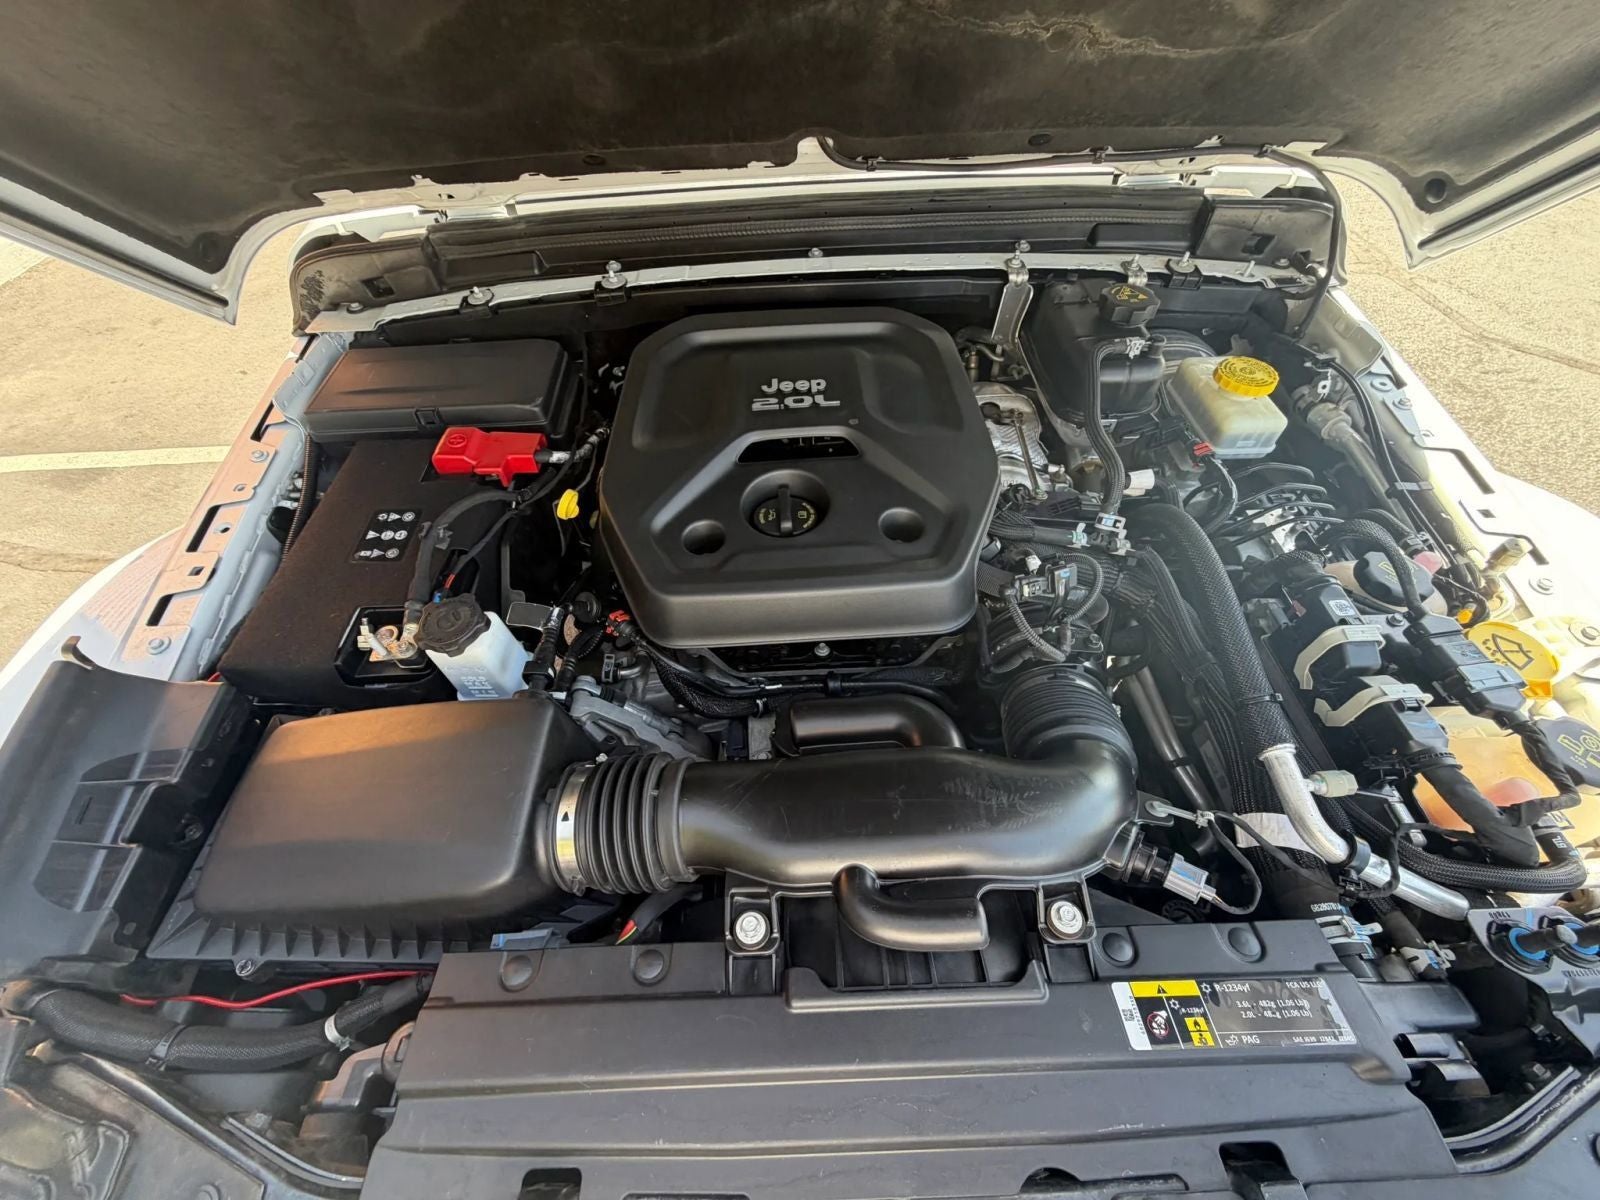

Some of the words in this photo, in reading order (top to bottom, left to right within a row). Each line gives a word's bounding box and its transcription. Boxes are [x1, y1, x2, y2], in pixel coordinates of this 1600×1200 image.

[761, 378, 827, 394] Jeep
[751, 394, 841, 411] 2.0L
[1241, 1034, 1261, 1045] PAG
